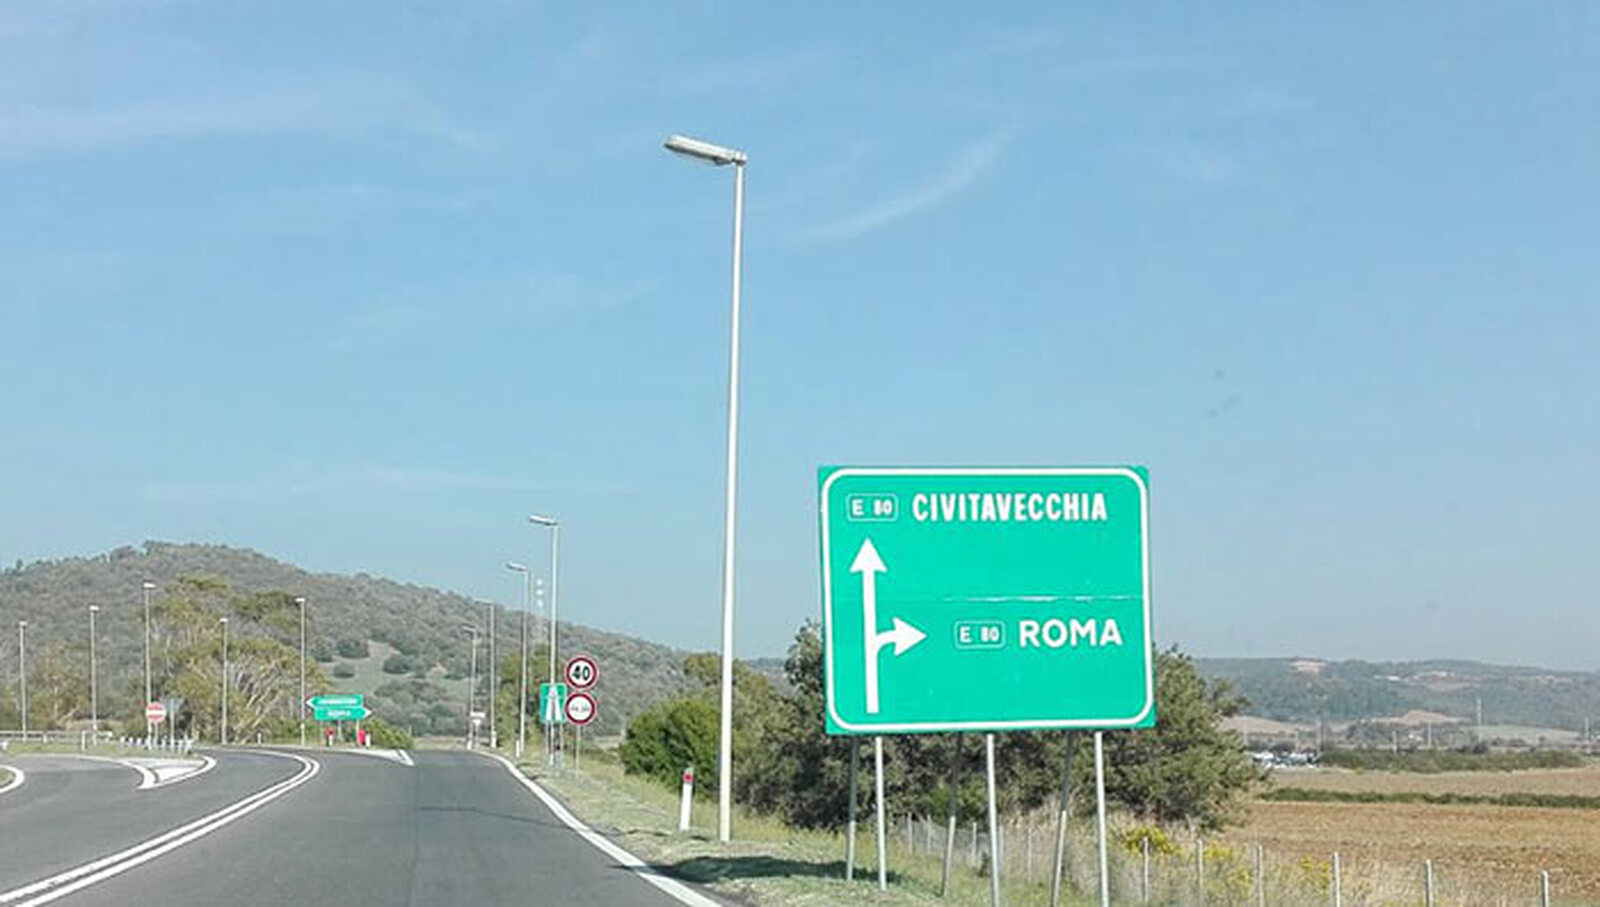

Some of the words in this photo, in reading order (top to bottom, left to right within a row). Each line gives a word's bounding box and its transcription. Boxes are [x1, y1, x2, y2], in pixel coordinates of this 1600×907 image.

[852, 500, 863, 515] E
[873, 500, 893, 515] 80
[912, 493, 1108, 521] CIVITAVECCHIA
[960, 626, 971, 642] E
[981, 626, 1000, 642] 80
[1019, 619, 1123, 648] ROMA
[572, 665, 590, 681] 40
